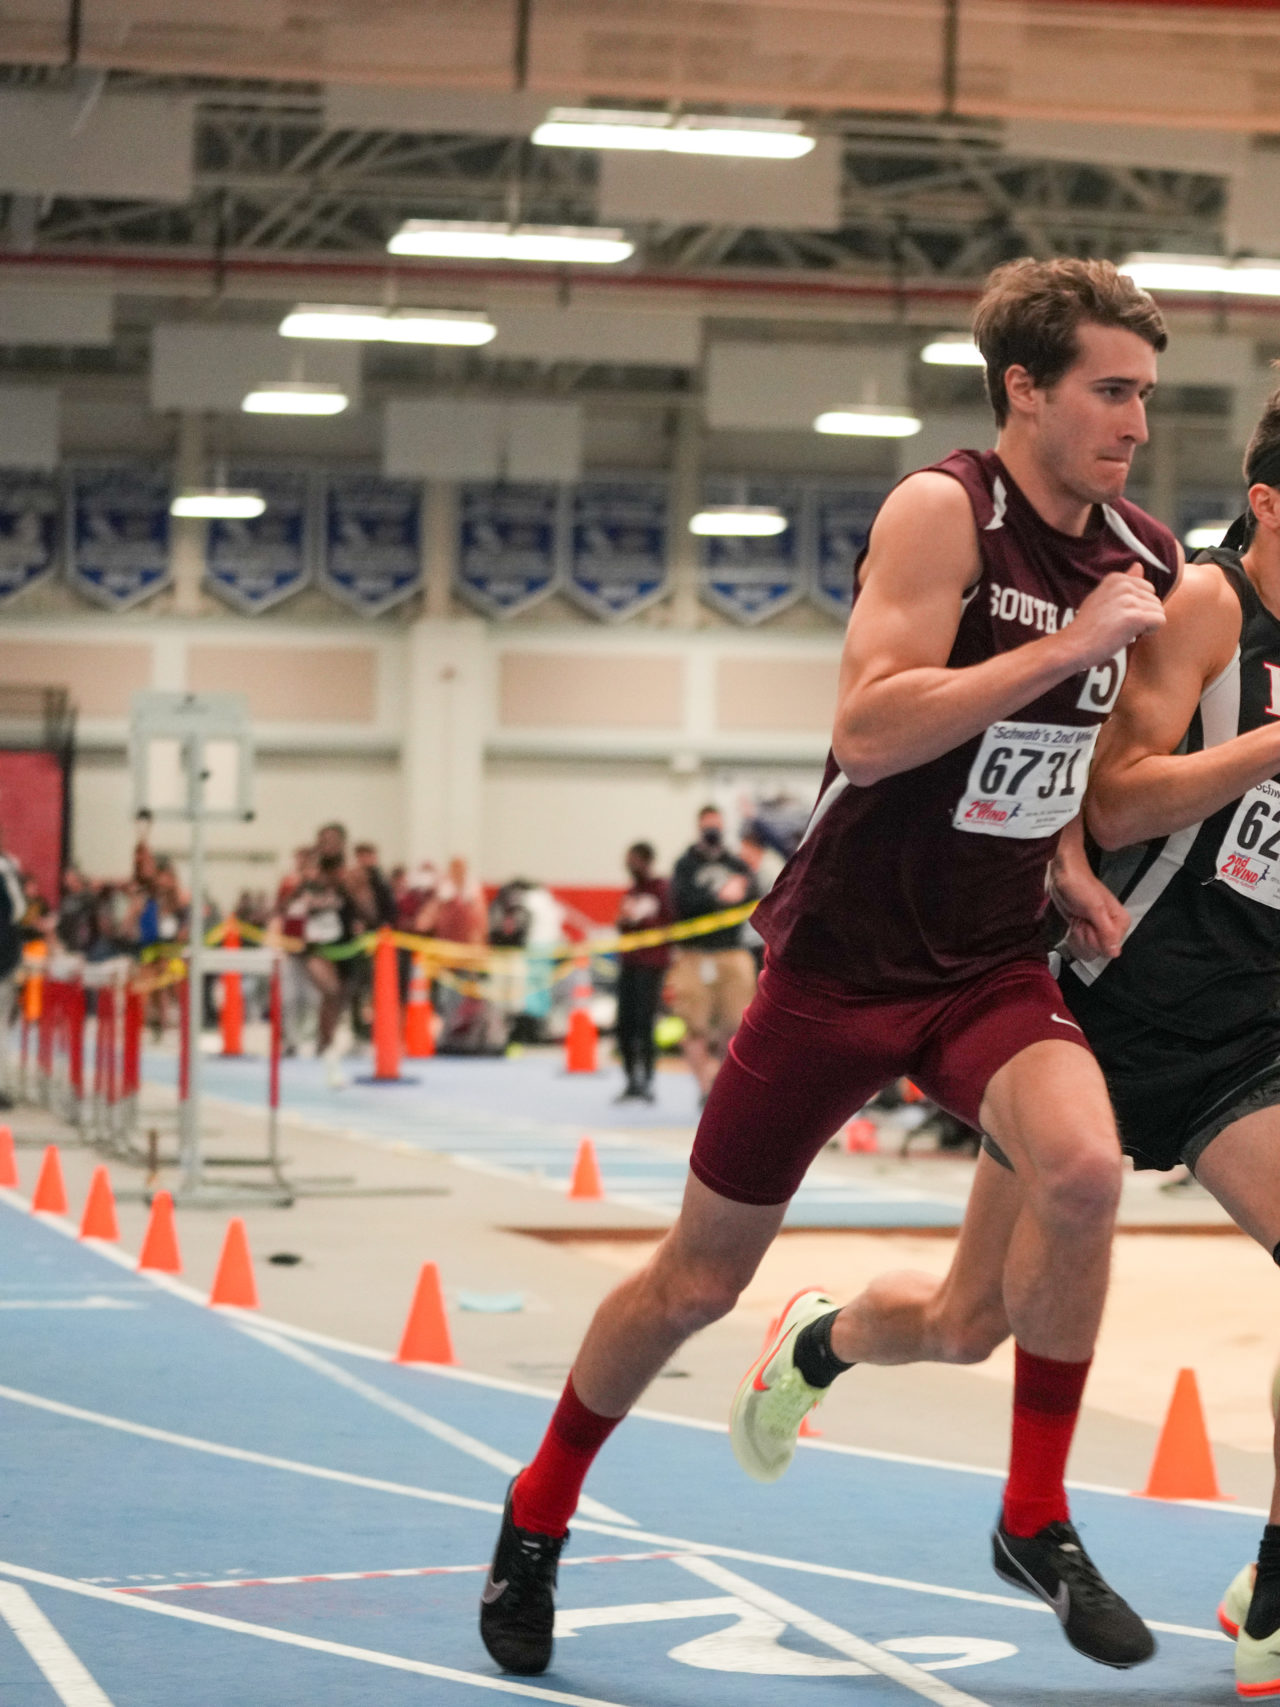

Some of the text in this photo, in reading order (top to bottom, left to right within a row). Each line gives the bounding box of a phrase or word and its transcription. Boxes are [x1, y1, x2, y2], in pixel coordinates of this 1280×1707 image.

[979, 746, 1082, 799] 6731
[1221, 854, 1252, 874] 2nd
[1231, 864, 1259, 884] WIND
